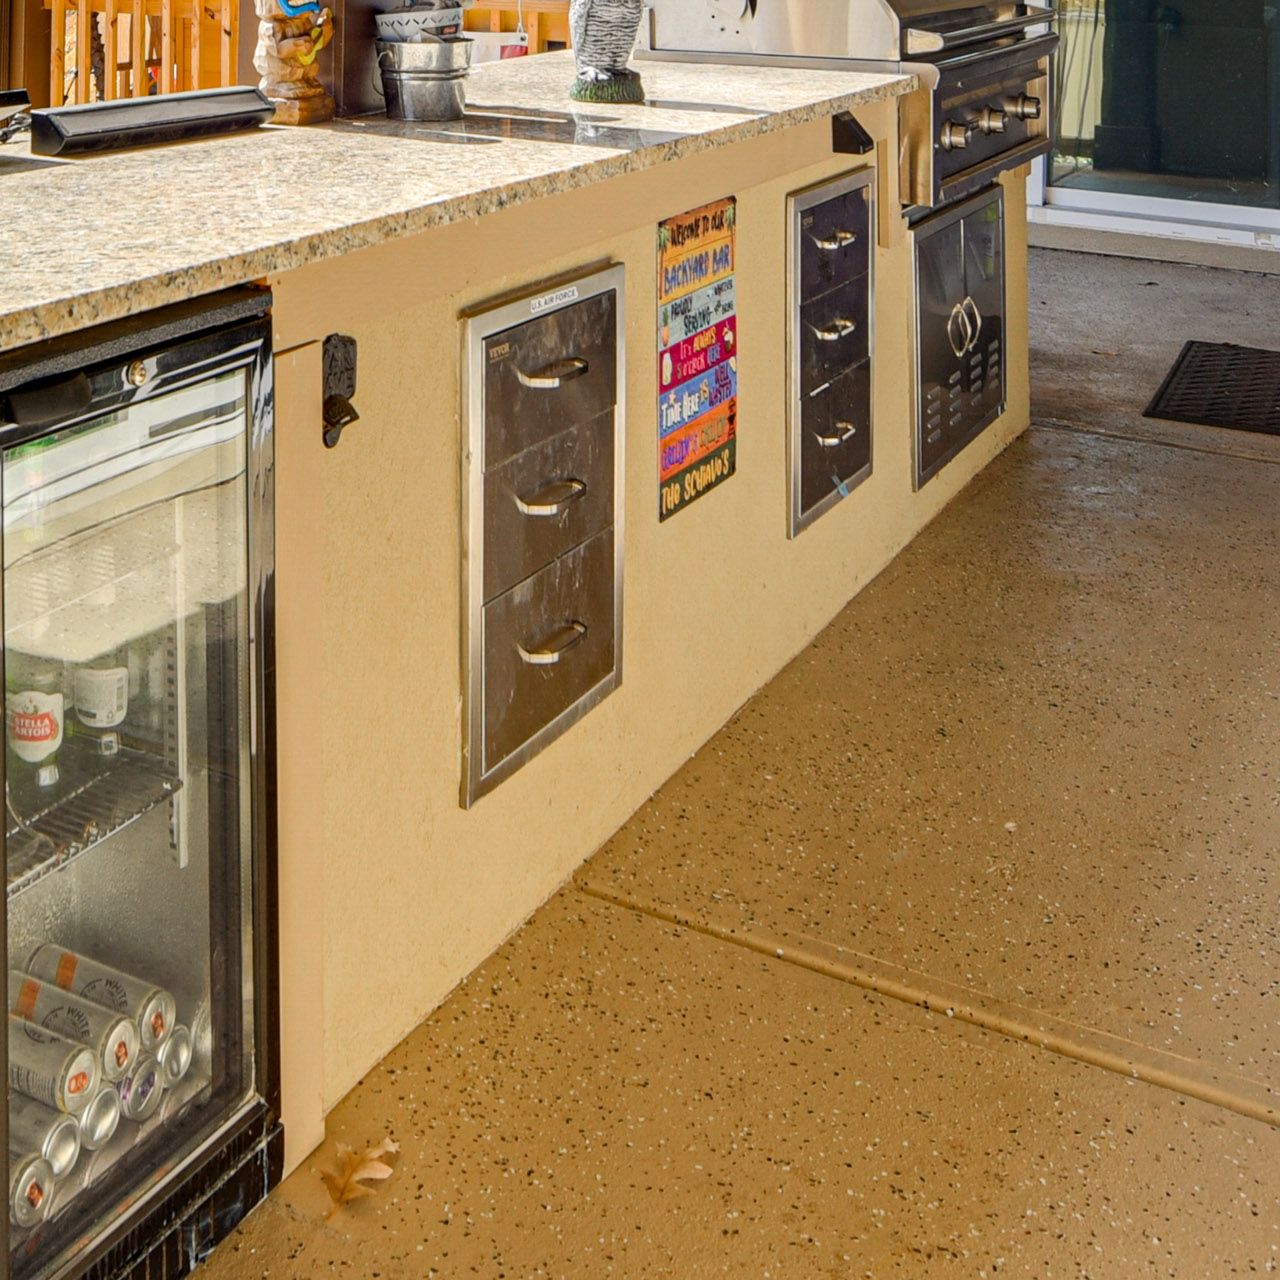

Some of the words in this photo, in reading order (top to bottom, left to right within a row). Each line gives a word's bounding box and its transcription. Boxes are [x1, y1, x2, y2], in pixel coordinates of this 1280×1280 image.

[670, 218, 701, 247] WELCOME
[702, 215, 709, 236] TO
[711, 209, 725, 231] OUR
[664, 251, 710, 297] BACKYARD
[712, 244, 730, 276] BAR
[104, 977, 129, 1009] WHITE
[65, 1005, 91, 1038] WHITE
